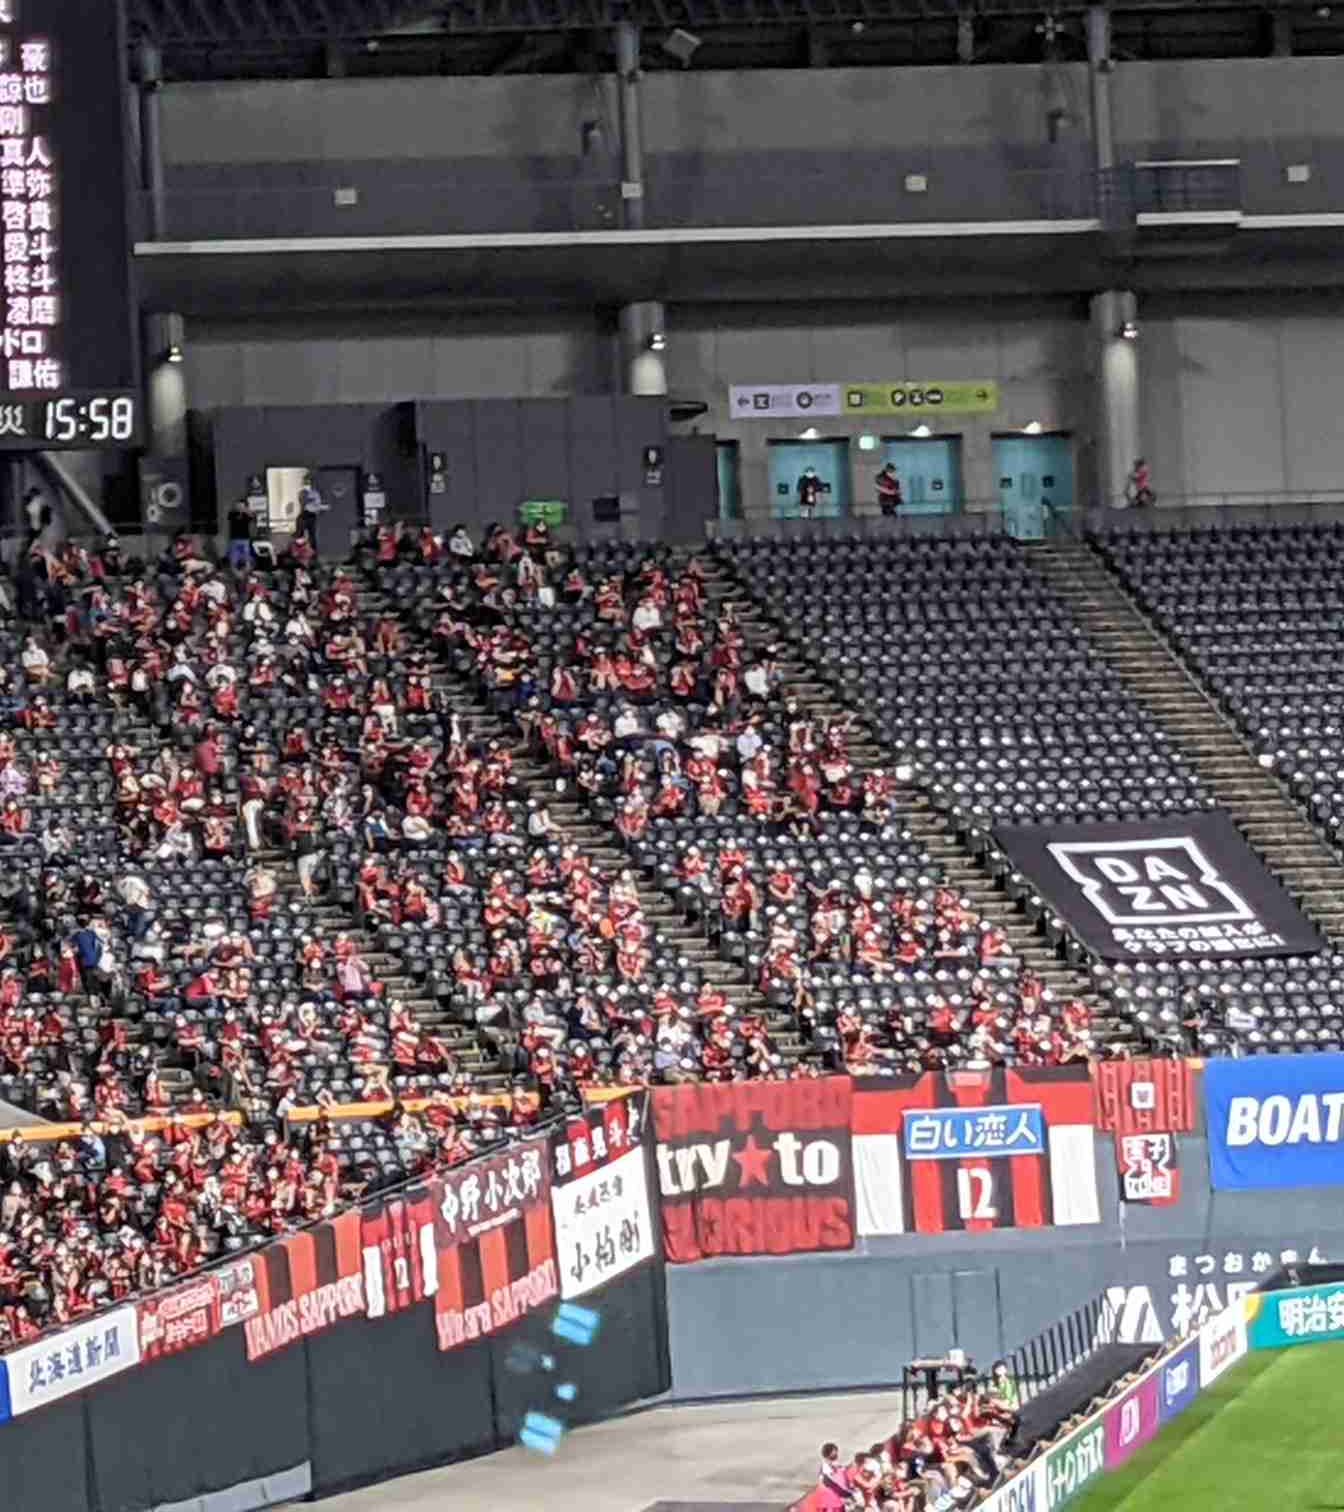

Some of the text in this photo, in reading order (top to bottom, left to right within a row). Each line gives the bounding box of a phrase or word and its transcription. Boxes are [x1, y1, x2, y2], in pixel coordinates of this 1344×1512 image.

[45, 398, 133, 441] 15:58
[911, 1111, 1039, 1152] 白い恋人
[1226, 1091, 1344, 1146] BOAT
[656, 1138, 731, 1196] try
[772, 1132, 840, 1186] to
[956, 1167, 998, 1220] 12
[29, 1326, 121, 1392] 北海道新聞
